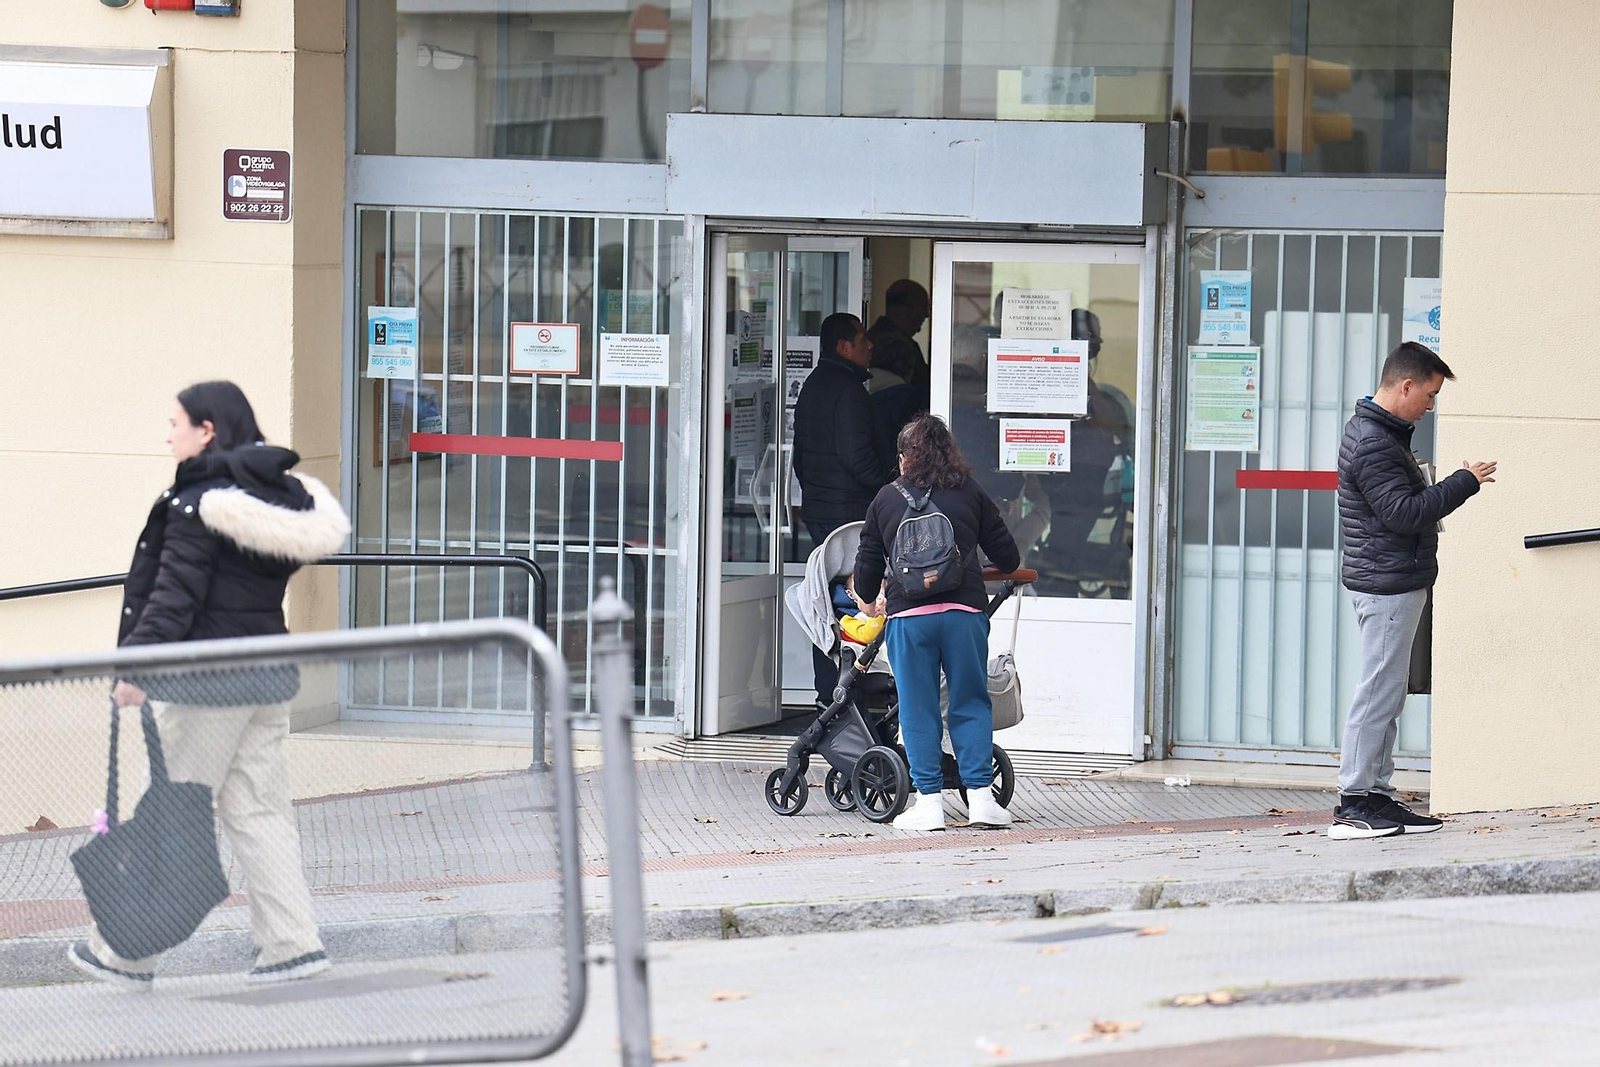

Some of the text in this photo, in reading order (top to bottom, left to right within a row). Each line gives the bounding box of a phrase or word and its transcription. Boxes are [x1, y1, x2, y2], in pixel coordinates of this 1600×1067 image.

[251, 162, 275, 170] control
[230, 203, 284, 213] 902 26 22 22
